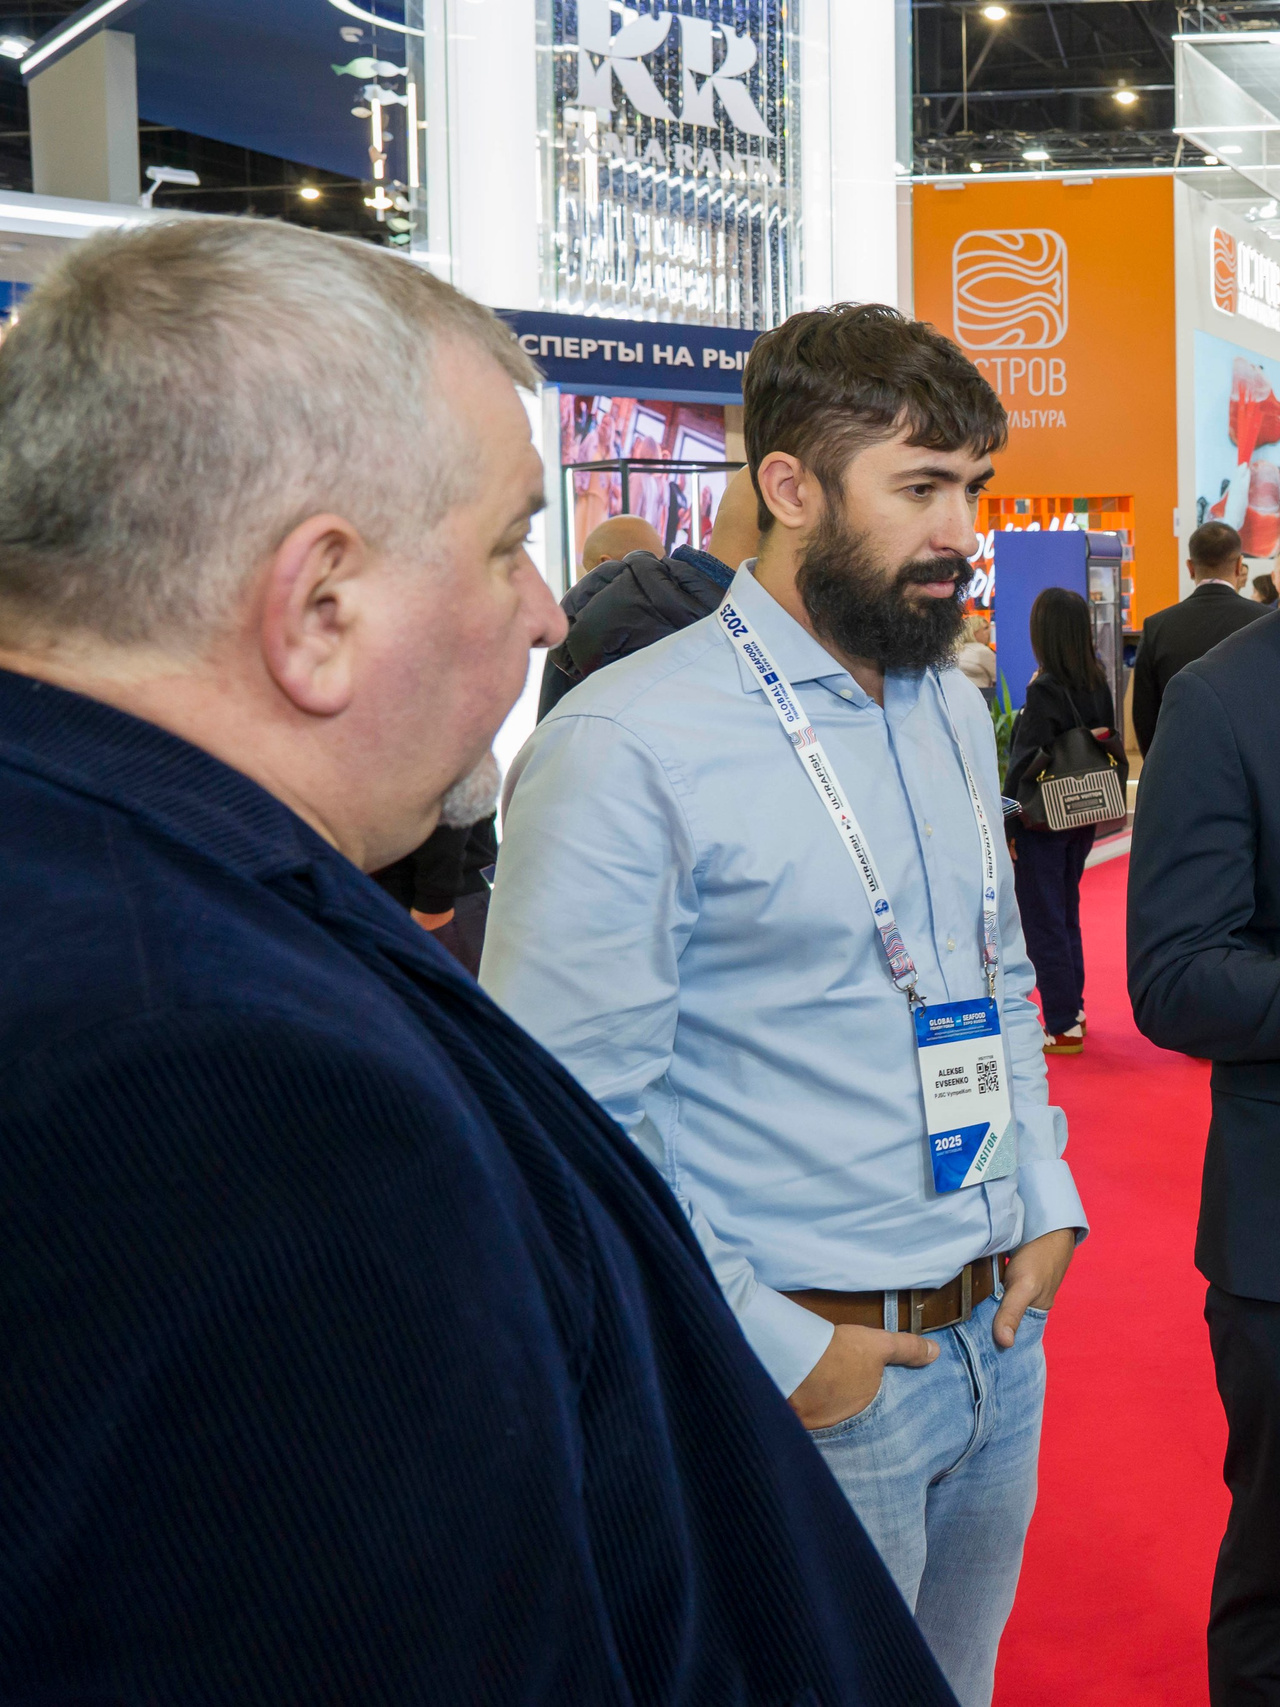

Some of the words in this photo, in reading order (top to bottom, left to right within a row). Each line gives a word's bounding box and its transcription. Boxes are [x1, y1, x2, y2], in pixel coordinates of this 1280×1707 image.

[674, 143, 779, 180] RANTA
[518, 333, 643, 363] СПЕРТЫ
[653, 344, 695, 367] НА
[702, 348, 750, 371] РЫ
[973, 357, 1067, 396] ТРОВ
[719, 603, 749, 638] 2025
[743, 643, 767, 674] SEAFOOD
[750, 641, 764, 658] RUSSIA
[761, 657, 773, 671] EXPO
[770, 685, 795, 723] GLOBAL
[808, 754, 841, 810] ULTRAFISH
[849, 835, 877, 892] ULTRAFISH
[982, 824, 994, 879] ULTRAFISH
[929, 1016, 954, 1027] GLOBAL
[962, 1012, 986, 1022] SEAFOOD
[935, 1076, 969, 1089] EVSEENKO
[938, 1066, 965, 1077] ALEKSEI
[934, 1134, 963, 1152] 2025
[974, 1132, 999, 1172] VISITOR
